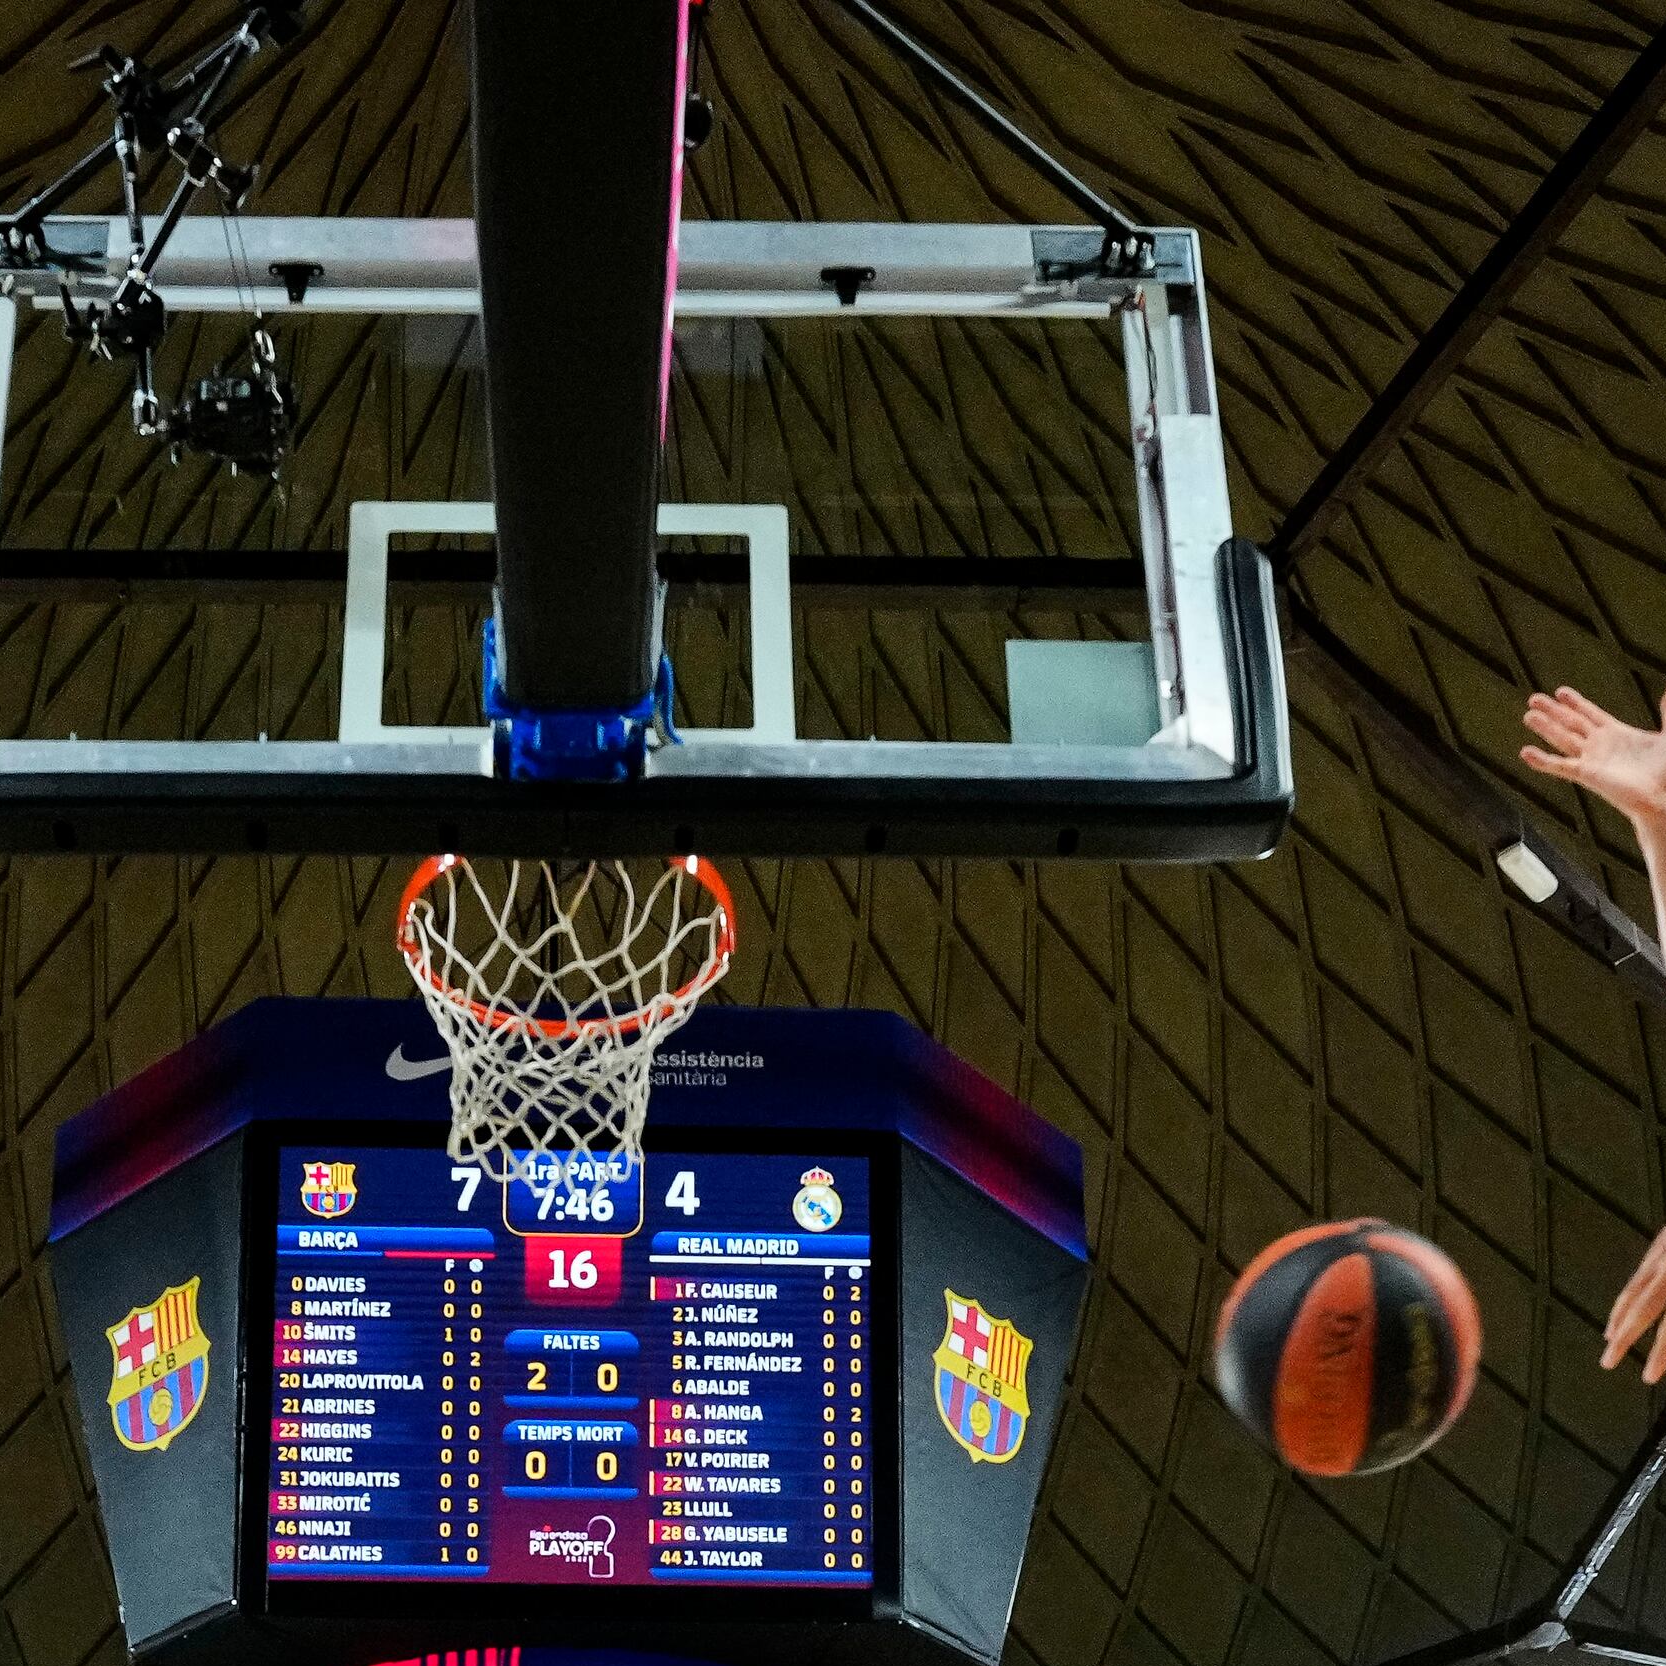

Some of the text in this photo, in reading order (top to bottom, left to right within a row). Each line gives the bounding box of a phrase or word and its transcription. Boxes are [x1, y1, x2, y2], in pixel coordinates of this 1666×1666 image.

[650, 1050, 764, 1069] ssistència
[528, 1160, 560, 1181] 1ra
[451, 1167, 482, 1212] 7
[665, 1171, 701, 1216] 4
[533, 1187, 614, 1222] 7:46
[298, 1231, 358, 1250] BARÇA
[677, 1237, 799, 1256] REAL MADRID
[445, 1258, 455, 1272] F
[548, 1249, 598, 1289] 16
[824, 1266, 834, 1280] F
[291, 1276, 482, 1295] 0 DAVIES 0 0
[675, 1282, 861, 1301] 1 F. CAUSEUR 0 2
[291, 1297, 482, 1319] 8 MARTÍNEZ 0 0
[672, 1303, 861, 1325] 2 J. NÚÑEZ 0 0
[283, 1322, 482, 1343] 10 ŠMITS 1 0
[672, 1330, 861, 1350] 3 A. RANDOLPH 0 0
[543, 1334, 600, 1351] FALTES
[282, 1348, 481, 1367] 14 HAYES 0 2
[672, 1352, 802, 1373] 5 R. FERNÁNDEZ
[279, 1373, 424, 1390] 20 LAPROVITTOLA
[527, 1362, 618, 1392] 2 0
[672, 1379, 750, 1396] 6 ABALDE
[281, 1398, 376, 1415] 21 ABRINES
[671, 1404, 862, 1423] 8 A. HANGA 0 2
[279, 1422, 372, 1440] 22 HIGGINS
[517, 1424, 624, 1442] TEMPS MORT
[664, 1428, 748, 1445] 14 G. DECK
[277, 1446, 353, 1463] 24 KURIC
[665, 1452, 770, 1469] 17 V. POIRIER
[525, 1451, 617, 1481] 0 0
[280, 1470, 400, 1488] 31 JOKUBAITIS
[662, 1476, 781, 1494] 22 W. TAVARES
[277, 1493, 479, 1513] 33 MIROTIĆ 0 5
[662, 1501, 733, 1517] 23 LLULL
[274, 1520, 351, 1537] 46 NNAJI
[661, 1525, 788, 1543] 28 G. YABUSELE
[275, 1544, 478, 1563] 99 CALATHES 1 0
[529, 1540, 605, 1556] PLAYOFF
[660, 1550, 763, 1567] 44 J. TAYLOR
